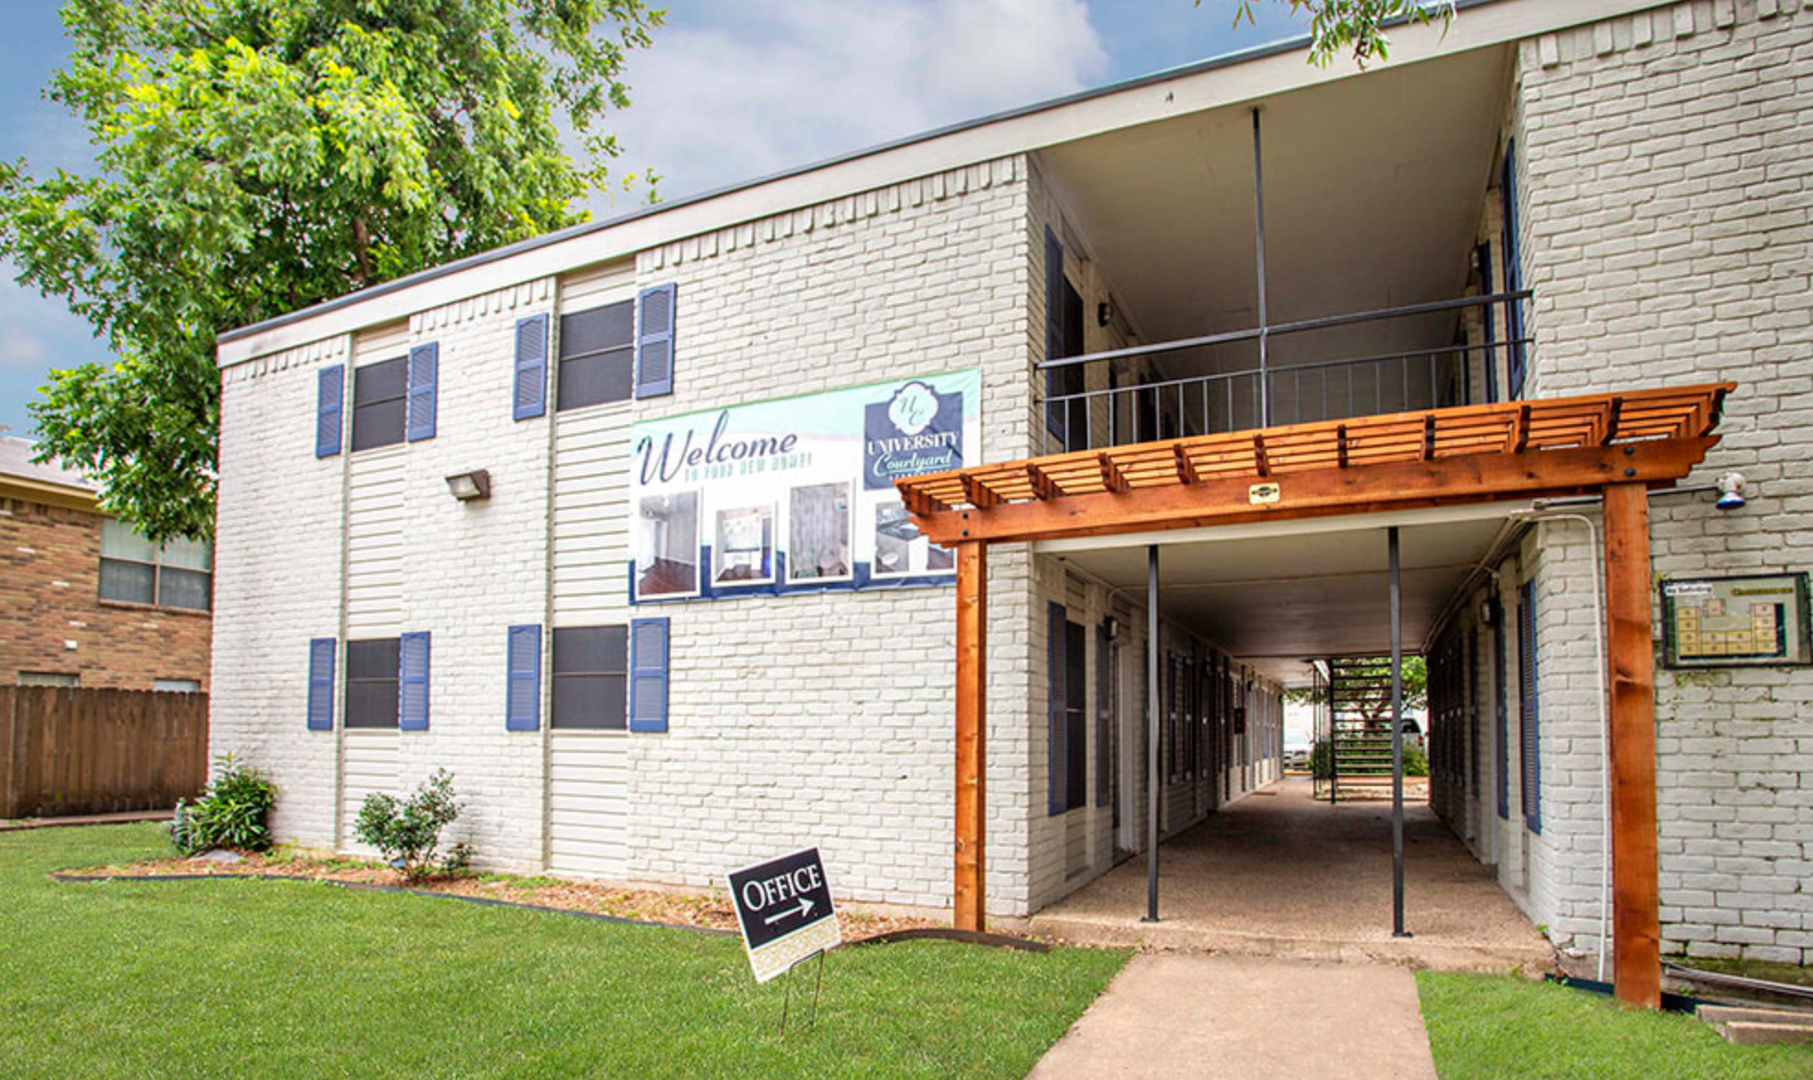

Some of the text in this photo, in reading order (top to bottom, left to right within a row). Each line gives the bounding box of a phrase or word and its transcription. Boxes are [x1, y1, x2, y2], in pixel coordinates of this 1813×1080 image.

[636, 408, 798, 486] Welcome
[867, 431, 957, 456] UNIVERSITY
[872, 449, 953, 477] Courtyard
[742, 864, 822, 912] OFFICE
